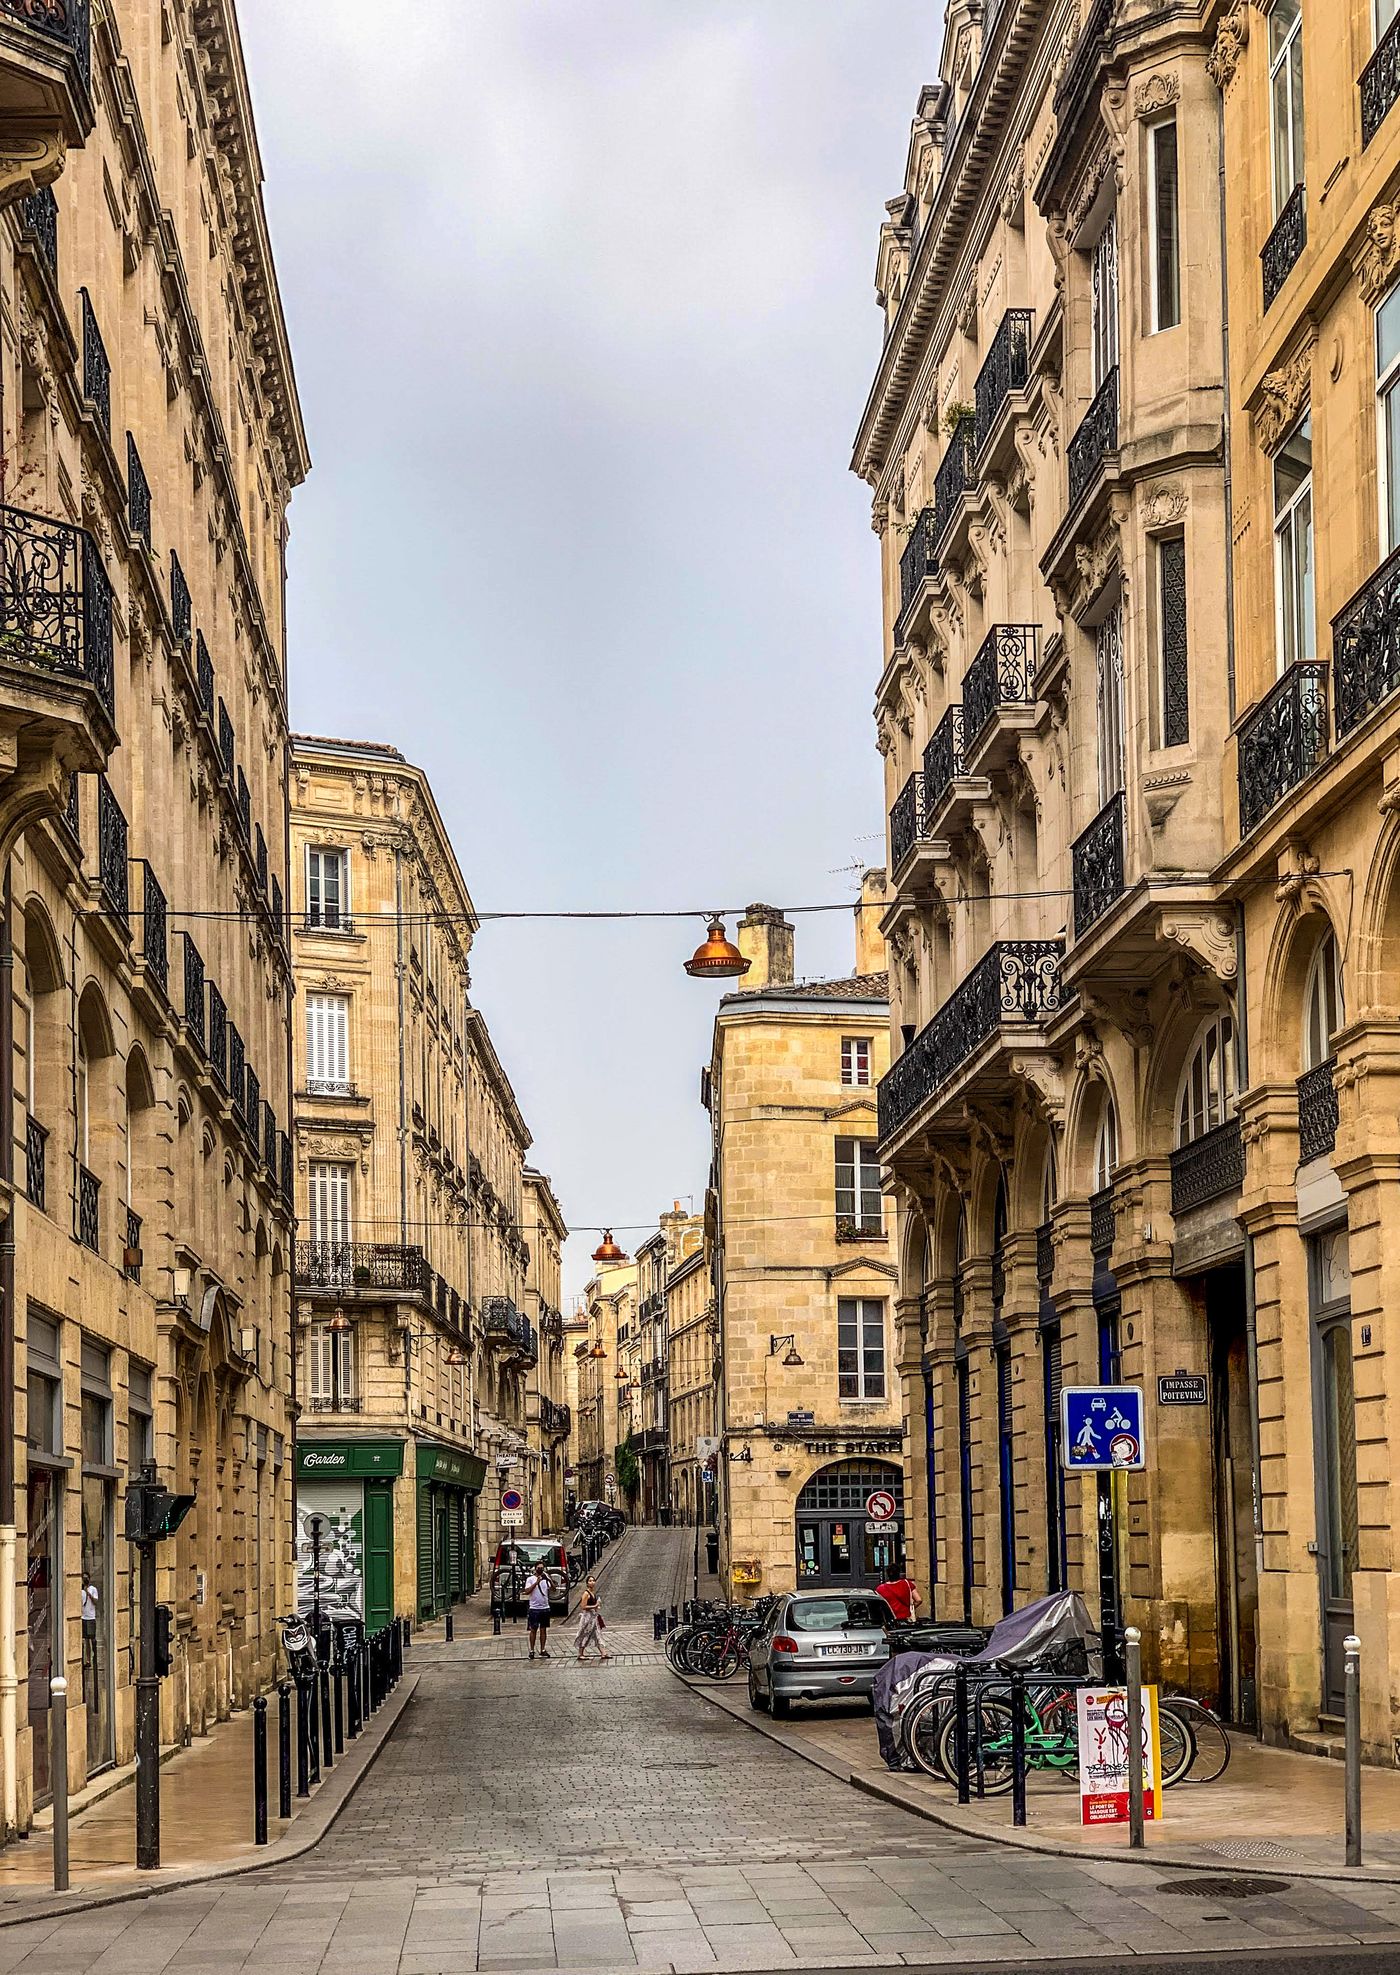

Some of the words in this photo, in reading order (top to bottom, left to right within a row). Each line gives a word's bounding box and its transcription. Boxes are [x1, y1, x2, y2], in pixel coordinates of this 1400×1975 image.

[1166, 1381, 1198, 1389] IMPASSE
[1163, 1391, 1203, 1399] POITEVINE
[805, 1442, 839, 1453] THE
[303, 1453, 346, 1467] Garden
